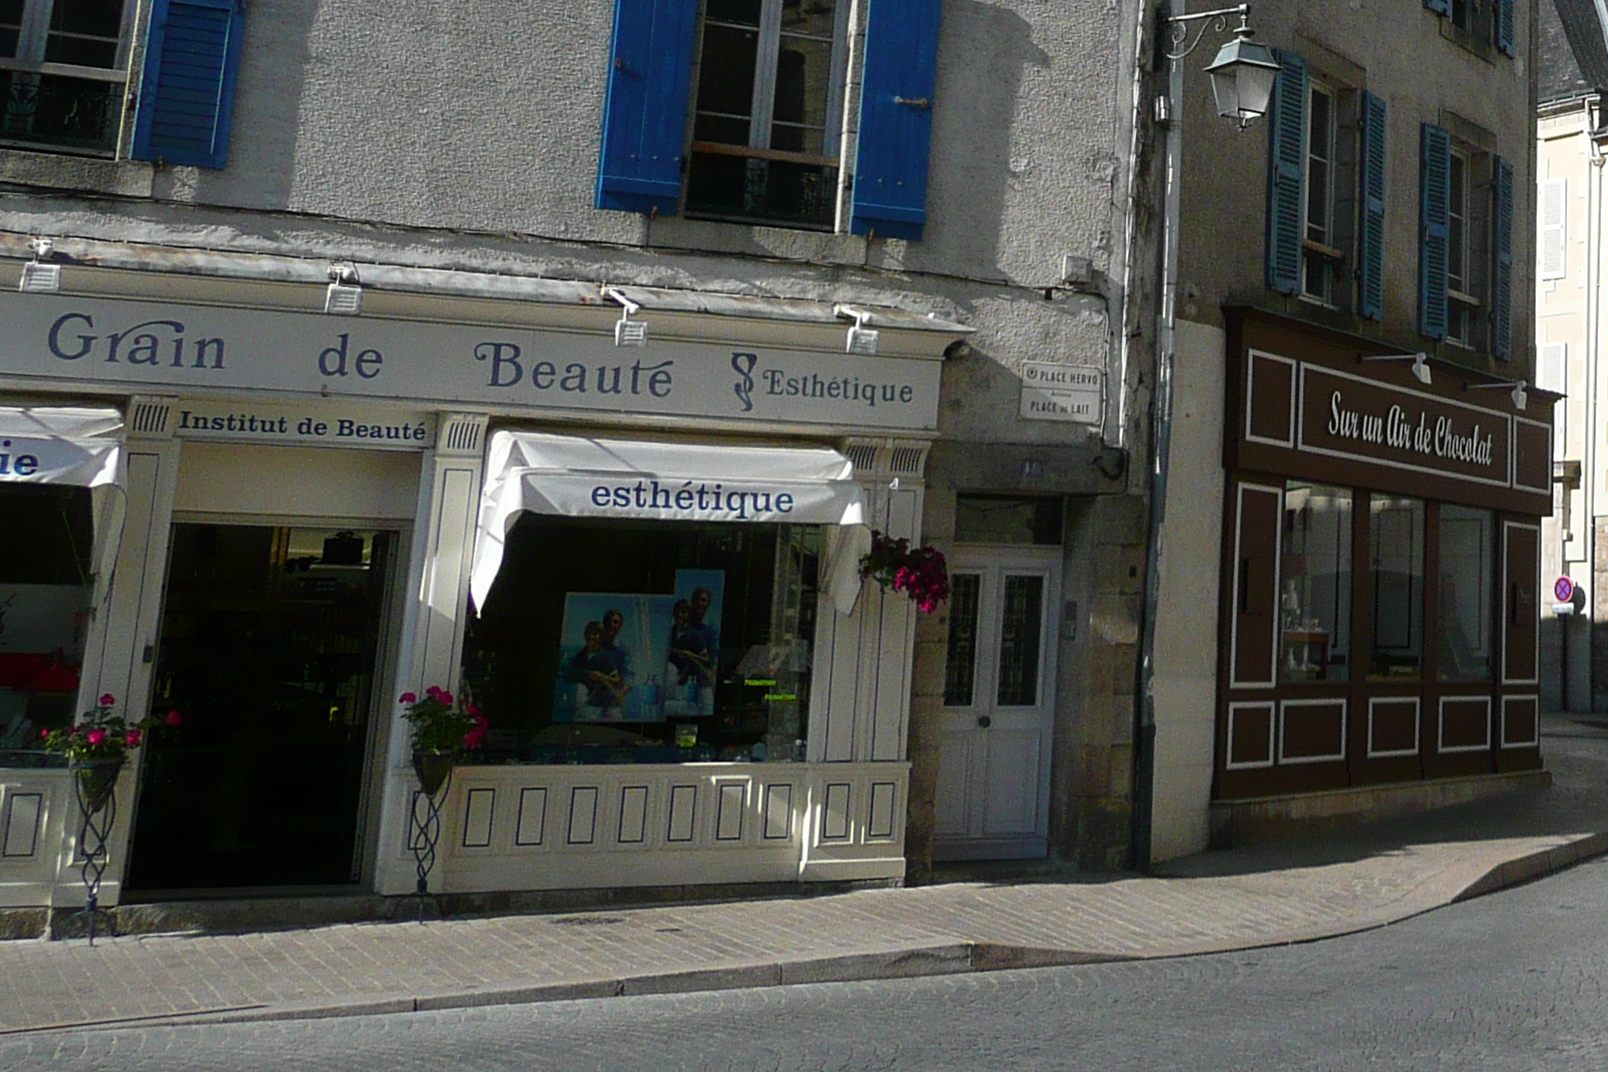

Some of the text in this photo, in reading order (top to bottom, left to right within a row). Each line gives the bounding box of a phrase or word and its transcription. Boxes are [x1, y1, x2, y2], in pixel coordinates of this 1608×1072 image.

[48, 312, 674, 398] Grain de Beauté
[762, 368, 914, 407] Esthétique
[1040, 370, 1067, 384] PLACE
[179, 410, 427, 441] Institut de Beauté
[1030, 400, 1057, 413] PLACE
[1071, 404, 1089, 415] LAIT
[1329, 390, 1493, 467] Sur un Air de Chocolat
[590, 480, 795, 520] esthétique
